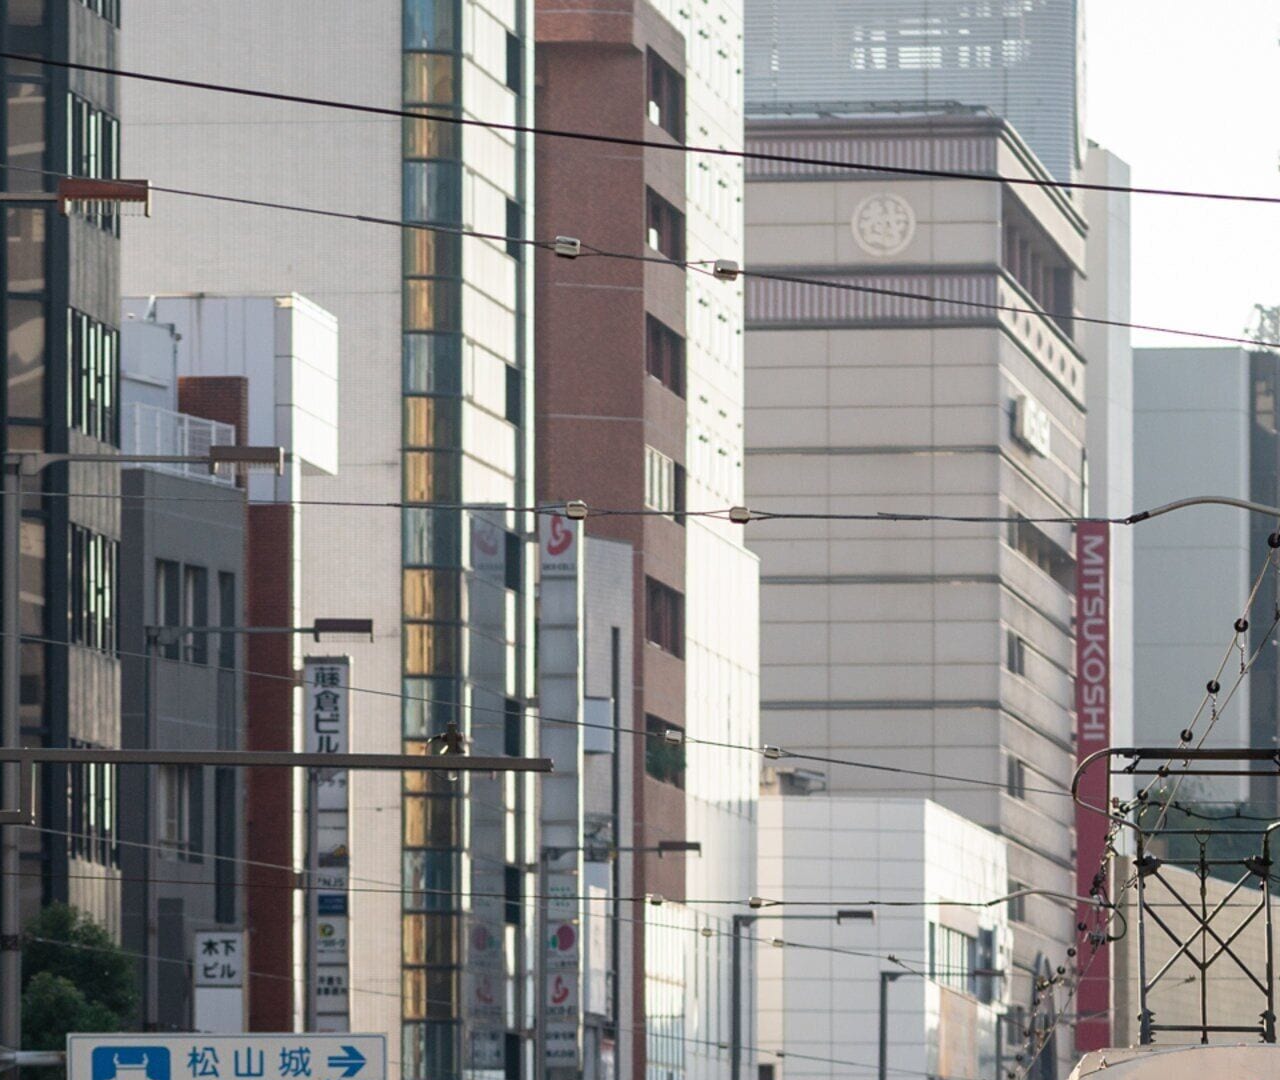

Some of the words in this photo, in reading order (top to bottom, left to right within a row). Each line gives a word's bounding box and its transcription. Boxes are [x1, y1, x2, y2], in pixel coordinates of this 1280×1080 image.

[1082, 535, 1107, 743] MITSUKOSHI
[202, 939, 237, 958] 木下
[202, 961, 237, 980] ビル
[187, 1046, 312, 1077] 松山城
